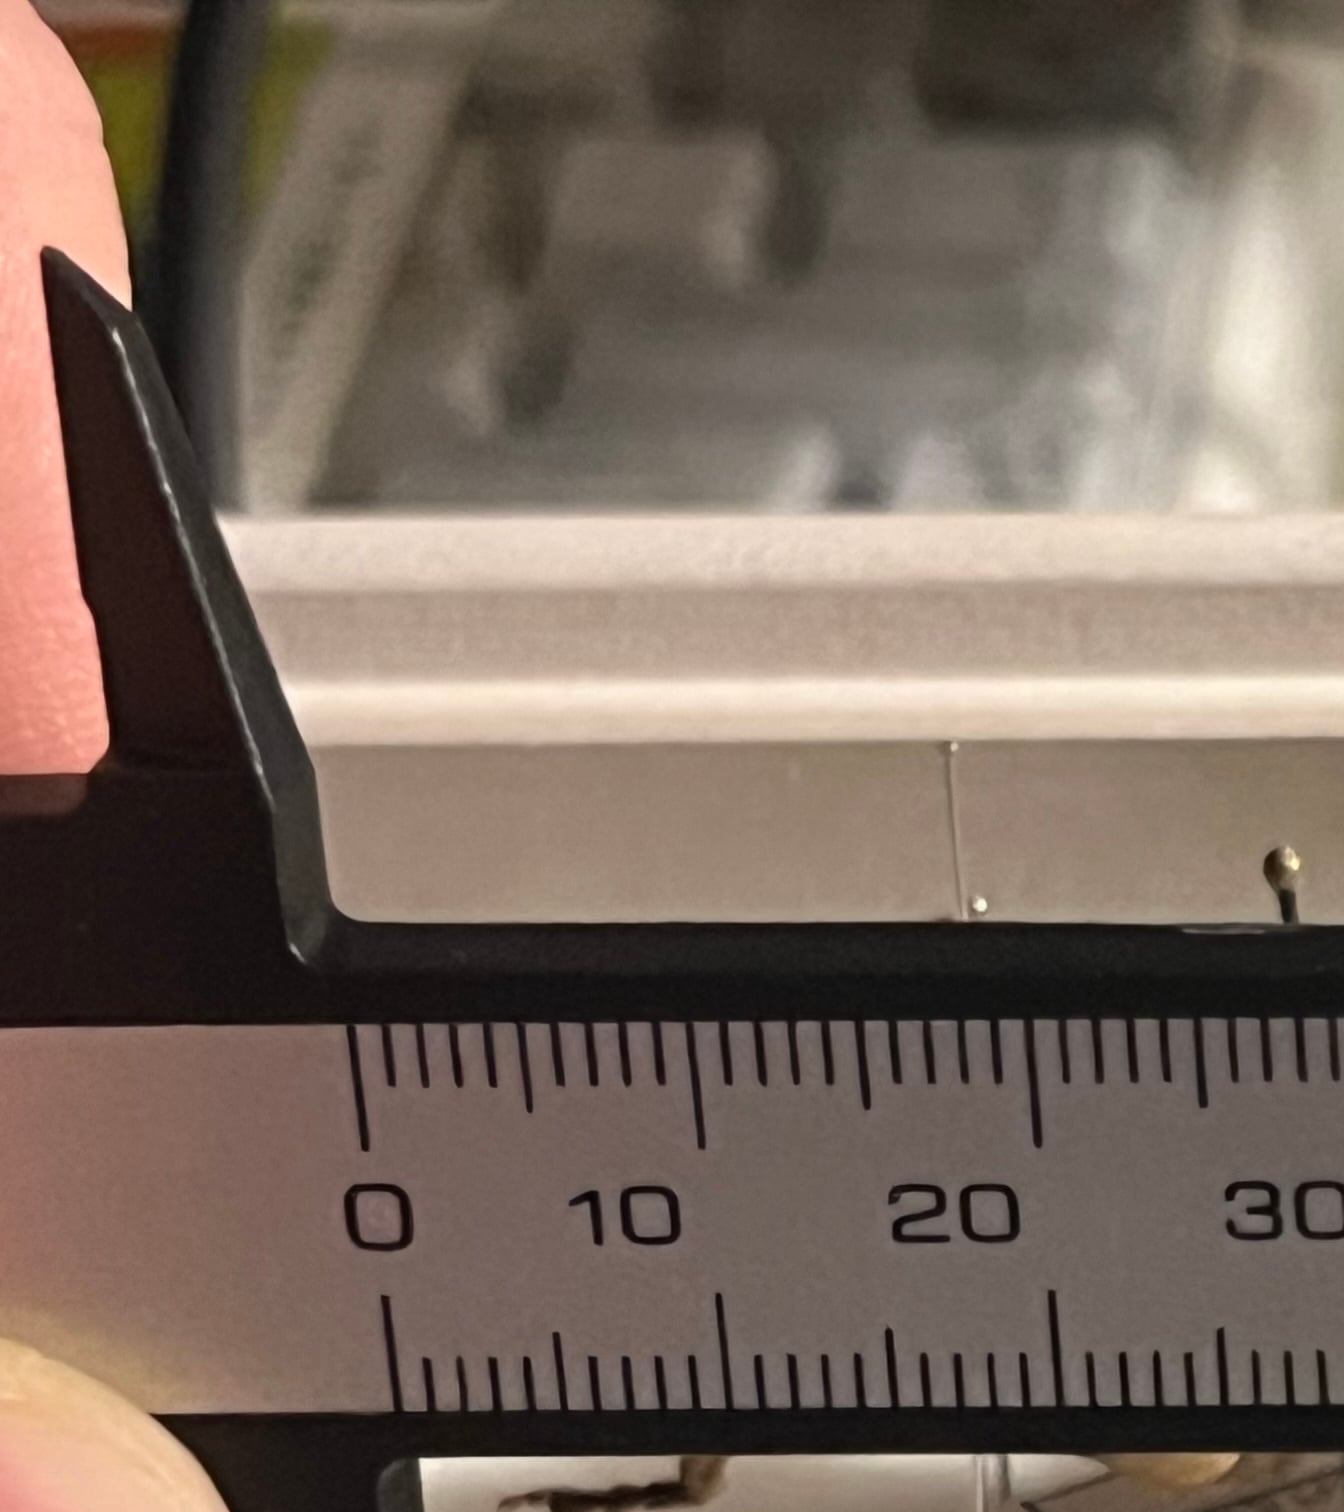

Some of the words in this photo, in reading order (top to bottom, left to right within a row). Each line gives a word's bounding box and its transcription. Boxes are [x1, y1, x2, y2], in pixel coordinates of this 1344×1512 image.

[342, 1181, 415, 1254] 0
[567, 1183, 683, 1248] 10
[886, 1181, 1022, 1245] 20
